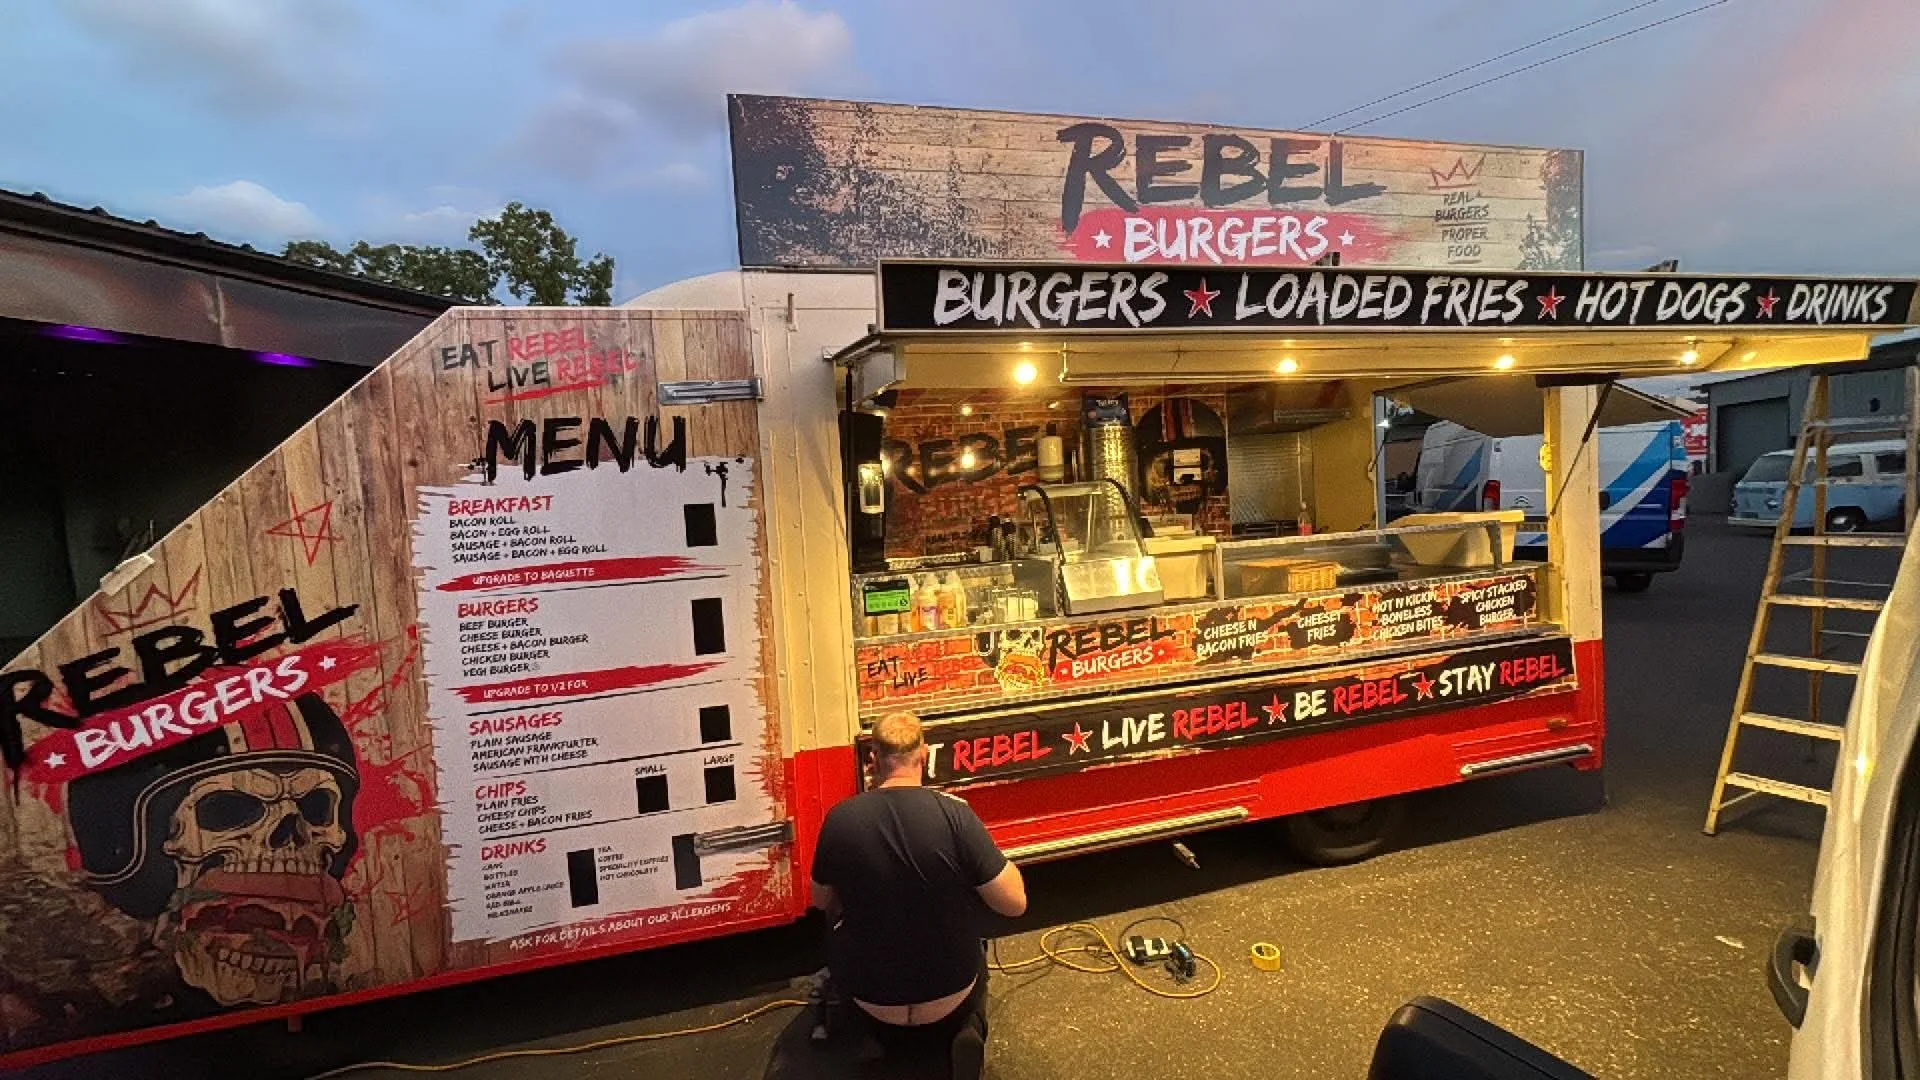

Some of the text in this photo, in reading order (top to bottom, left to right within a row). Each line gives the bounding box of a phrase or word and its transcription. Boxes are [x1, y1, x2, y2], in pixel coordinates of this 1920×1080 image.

[1056, 122, 1387, 239] REBEL
[1444, 191, 1474, 206] REAL
[1434, 204, 1490, 222] BURGERS
[1123, 215, 1330, 264] BURGERS
[1442, 227, 1488, 242] PROPER
[1448, 244, 1481, 258] FOOD
[933, 270, 1894, 328] BURGERS LOADED FRIES HOT DOGS DRINKS
[441, 328, 592, 370] EAT REBEL
[488, 349, 639, 392] LIVE REBEL
[485, 416, 686, 482] MENU
[448, 495, 554, 516] BREAKFAST
[450, 516, 516, 528] BACON ROLL
[450, 529, 487, 540] BACON
[498, 527, 520, 537] EGG
[523, 525, 550, 534] ROLL
[451, 539, 500, 552] SAUSAGE
[510, 536, 547, 548] BACON
[550, 535, 576, 544] ROLL
[453, 550, 500, 564] SAUSAGE
[511, 548, 547, 559] BACON
[557, 546, 579, 555] EGG
[582, 544, 608, 554] ROLL
[472, 567, 595, 585] UPGRADE TO BAGUETTE
[1460, 579, 1527, 604] SPICY STACKED
[457, 597, 538, 618] BURGERS
[1372, 599, 1394, 613] HOT
[1396, 597, 1403, 608] N
[1476, 595, 1515, 612] CHICKEN
[459, 617, 529, 632] BEEF BURGER
[1380, 605, 1432, 625] BONELESS
[1480, 608, 1517, 626] BURGER
[459, 628, 543, 643] CHEESE BURGER
[1204, 619, 1257, 640] CHEESE N
[1307, 624, 1336, 642] FRIES
[1372, 616, 1443, 641] CHICKEN BITES
[461, 643, 500, 654] CHEESE
[509, 638, 547, 651] BACON
[549, 633, 589, 646] BURGER
[1047, 617, 1176, 674] REBEL
[1197, 630, 1269, 656] BACON FRIES
[462, 650, 550, 666] CHICKEN BURGER
[490, 663, 530, 674] BURGER
[867, 656, 899, 678] EAT
[1071, 647, 1153, 678] BURGERS
[0, 587, 360, 772] REBEL
[894, 667, 928, 689] LIVE
[483, 685, 531, 698] UPGRADE
[534, 683, 549, 694] TO
[568, 680, 589, 689] FOR
[74, 656, 309, 768] BURGERS
[953, 730, 1052, 772] REBEL
[1101, 712, 1165, 748] LIVE
[1172, 701, 1258, 741] REBEL
[1294, 689, 1327, 721] BE
[1333, 679, 1408, 715] REBEL
[1439, 662, 1496, 697] STAY
[1500, 654, 1565, 687] REBEL
[469, 711, 563, 736] SAUSAGES
[470, 732, 552, 750] PLAIN SAUSAGE
[471, 737, 599, 761] AMERICAN FRANKFURTER
[473, 749, 588, 772] SAUSAGE WITH CHEESE
[635, 764, 667, 776] SMALL
[703, 753, 735, 766] LARGE
[475, 780, 527, 800] CHIPS
[476, 795, 539, 812] PLAIN FRIES
[477, 806, 546, 822] CHEESY CHIPS
[478, 821, 517, 834] CHEESE
[528, 815, 562, 827] BACON
[565, 810, 592, 822] FRIES
[481, 838, 546, 860] DRINKS
[510, 902, 731, 950] ASK FOR DETAILS ABOUT OUR ALLERGENS
